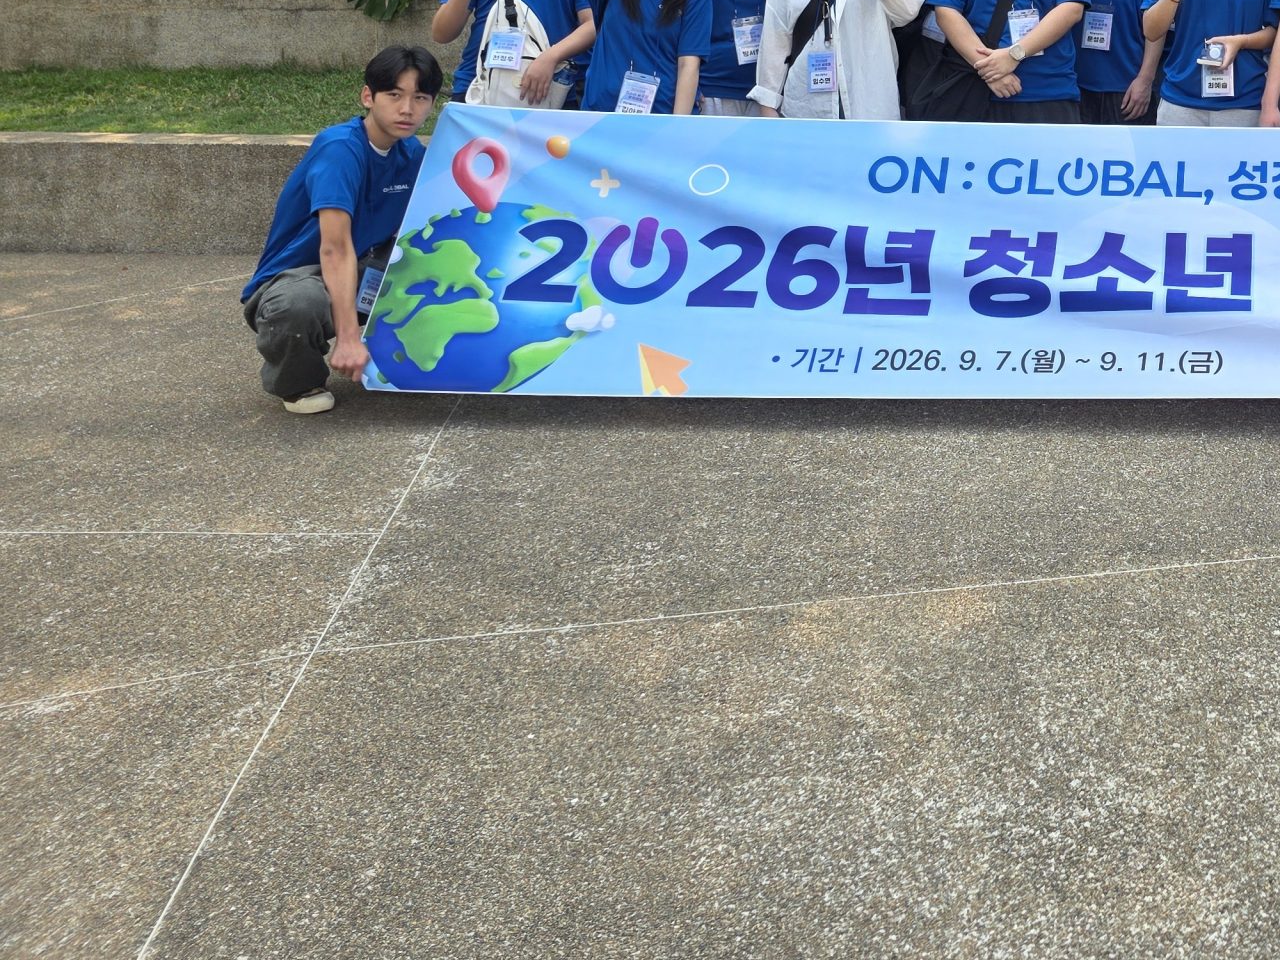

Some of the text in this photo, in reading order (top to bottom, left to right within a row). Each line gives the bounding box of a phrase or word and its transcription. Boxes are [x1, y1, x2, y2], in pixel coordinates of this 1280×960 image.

[868, 155, 950, 194] ON
[502, 216, 936, 317] 2026년
[963, 228, 1253, 318] 청소년
[790, 347, 845, 373] 기간
[871, 348, 947, 372] 2026.
[958, 349, 983, 372] 9.
[995, 348, 1067, 374] 7.(월)
[1099, 351, 1123, 373] 9.
[1138, 350, 1224, 375] 11.(금)
